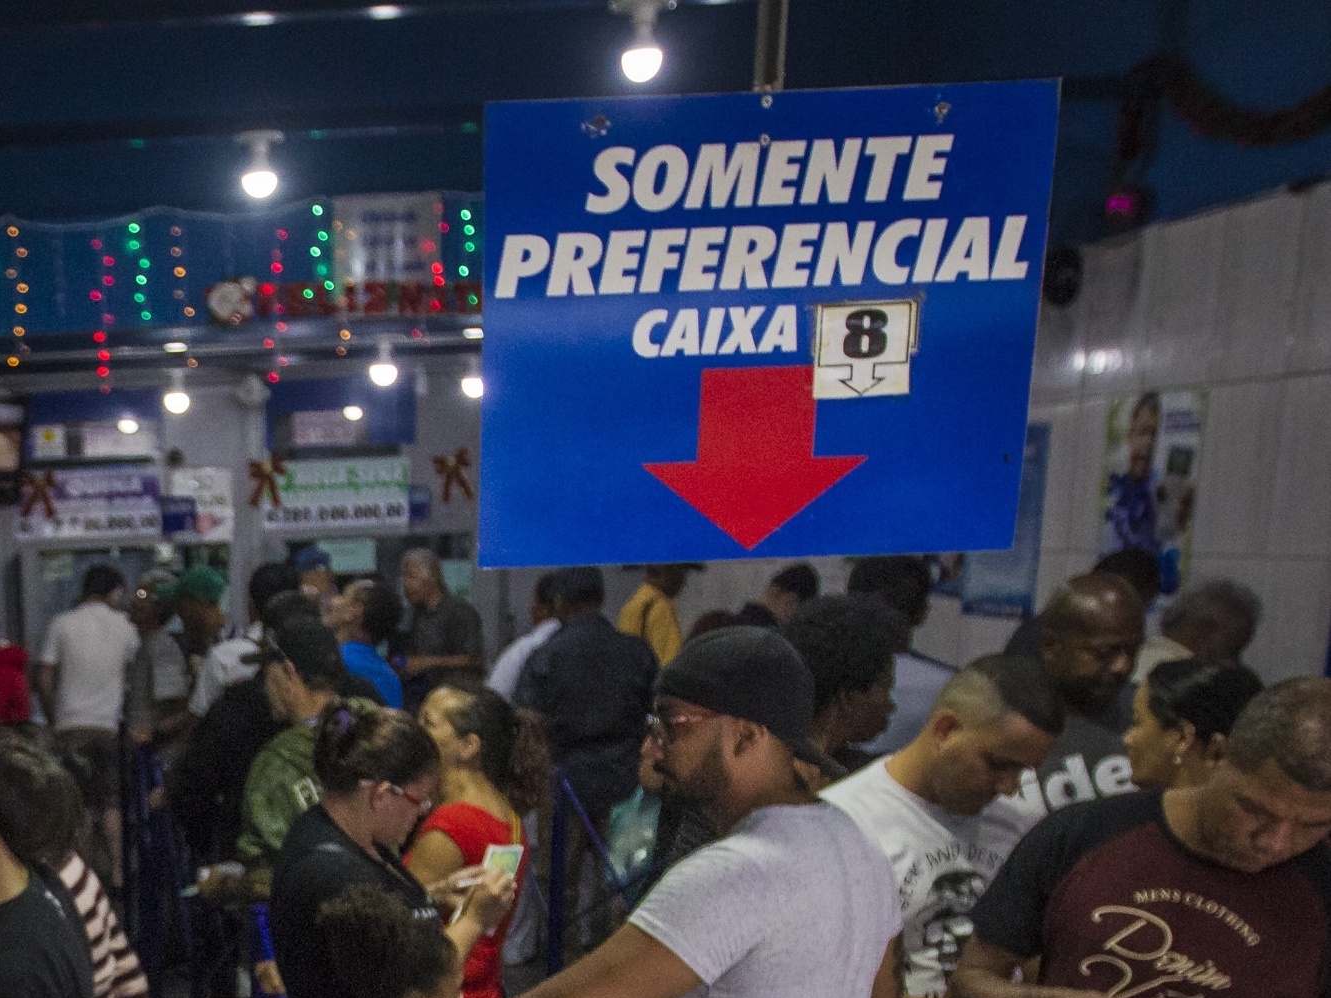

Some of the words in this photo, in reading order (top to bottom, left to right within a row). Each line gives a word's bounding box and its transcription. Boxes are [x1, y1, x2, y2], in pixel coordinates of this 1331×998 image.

[585, 133, 955, 215] SOMENTE
[494, 215, 1028, 298] PREFERENCIAL
[632, 304, 798, 358] CAIXA
[841, 308, 888, 359] 8
[1133, 887, 1181, 904] MENS
[1183, 891, 1260, 946] CLOTHING
